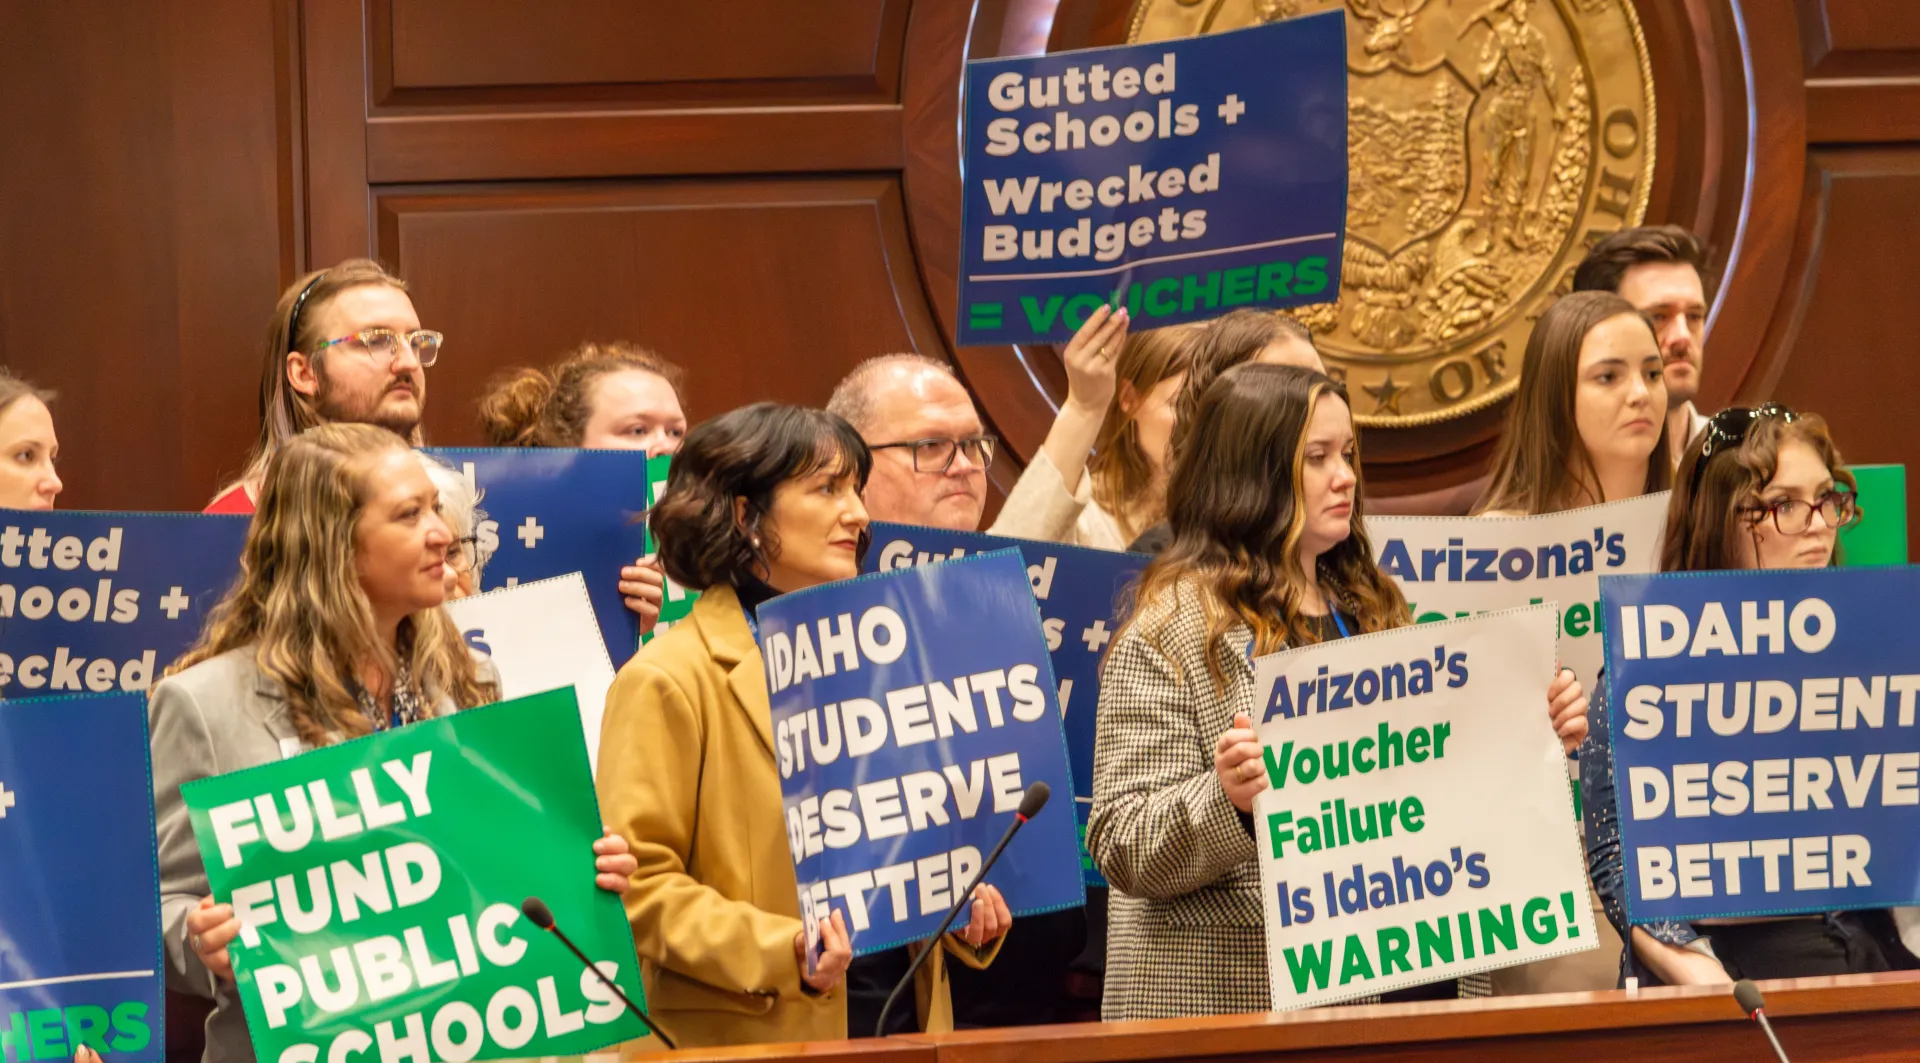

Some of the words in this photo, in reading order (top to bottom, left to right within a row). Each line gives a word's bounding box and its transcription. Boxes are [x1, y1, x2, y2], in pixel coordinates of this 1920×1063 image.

[988, 52, 1176, 111] Gutted
[985, 99, 1199, 156] Schools
[1218, 94, 1245, 125] +
[983, 153, 1220, 216] Wrecked
[983, 207, 1207, 261] Budgets
[970, 302, 1003, 330] =
[1019, 256, 1330, 333] VOUCHERS
[1429, 338, 1508, 404] OF
[0, 526, 123, 571] tted
[1377, 526, 1626, 582] Arizona’s
[0, 579, 140, 624] ools
[159, 586, 189, 619] +
[1620, 597, 1836, 660] IDAHO
[765, 605, 907, 695] IDAHO
[1261, 645, 1469, 724] Arizona’s
[1623, 674, 1920, 740] STUDENT
[777, 664, 1045, 779] STUDENTS
[1263, 721, 1451, 790] Voucher
[1629, 752, 1920, 820] DESERVE
[208, 751, 432, 869] FULLY
[787, 752, 1025, 864] DESERVE
[1267, 796, 1425, 860] Failure
[231, 841, 442, 948] FUND
[1276, 881, 1315, 928] Is
[1323, 847, 1490, 918] Idaho’s
[1637, 834, 1872, 900] BETTER
[254, 903, 528, 1029] PUBLIC
[1282, 891, 1580, 995] WARNING!
[0, 1001, 151, 1062] HERS
